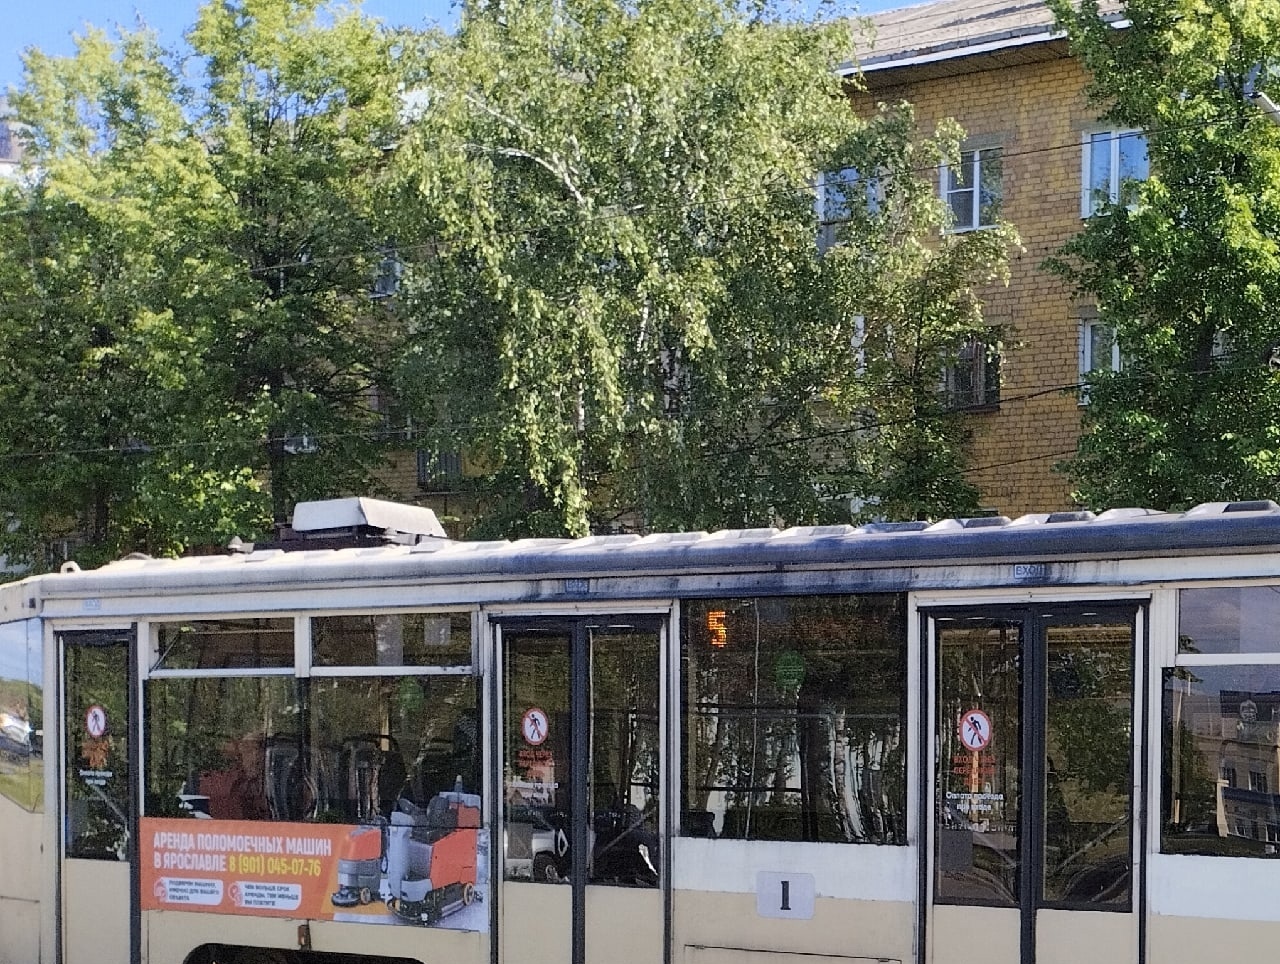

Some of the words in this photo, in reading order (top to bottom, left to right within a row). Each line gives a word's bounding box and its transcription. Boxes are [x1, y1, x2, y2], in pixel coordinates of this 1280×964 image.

[707, 611, 727, 649] 5
[153, 831, 195, 852] АРЕНДА
[197, 833, 283, 854] ПОЛОМОЕЧНЫХ
[286, 837, 331, 857] МАШИН
[153, 851, 162, 869] В
[163, 853, 228, 872] ЯРОСЛАВЛЕ
[229, 855, 236, 873] 8
[239, 855, 265, 876] (901)
[267, 857, 321, 877] 045-07-76
